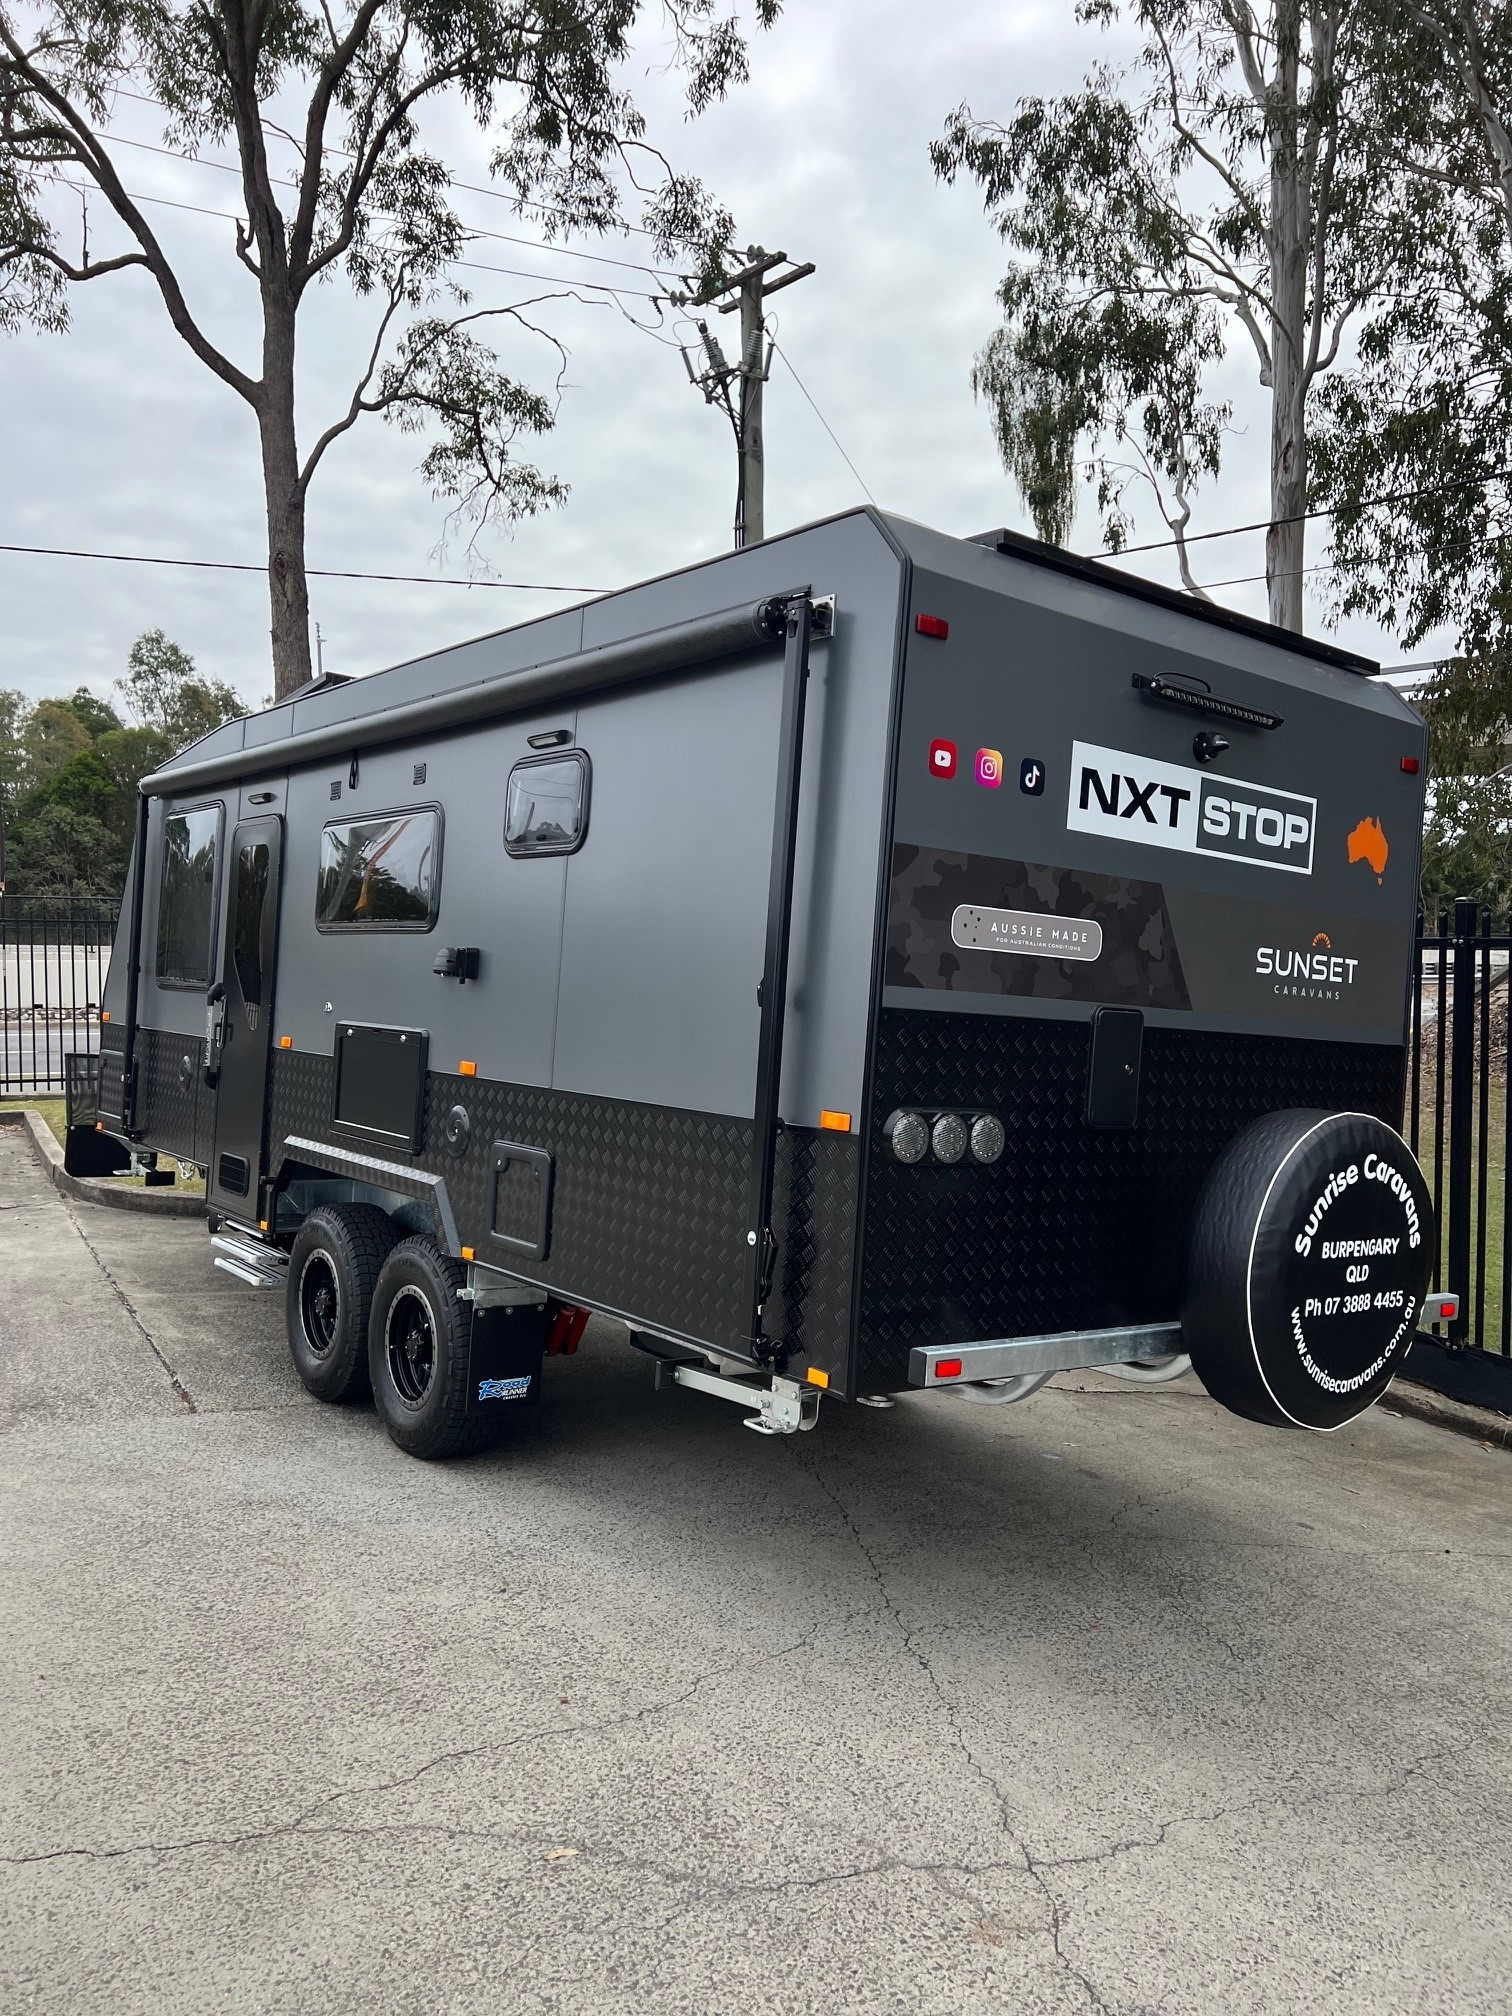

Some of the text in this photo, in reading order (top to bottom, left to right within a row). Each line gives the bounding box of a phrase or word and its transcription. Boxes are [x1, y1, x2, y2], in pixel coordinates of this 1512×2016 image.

[1079, 766, 1310, 849] NXT STOP
[990, 921, 1088, 943] AUSSIE MADE
[1010, 939, 1047, 948] AUSTRALIAN
[1047, 942, 1082, 952] CONDITIONS
[1256, 947, 1359, 984] SUNSET
[1274, 985, 1340, 1000] CARAVANS
[1295, 1153, 1421, 1258] Sunrise Caravans
[1321, 1237, 1400, 1259] BURPENGARY
[1346, 1264, 1370, 1283] QLD
[1304, 1290, 1404, 1318] Ph 07 3888 4455
[1291, 1295, 1416, 1393] www.sunrisecaravans.com.au
